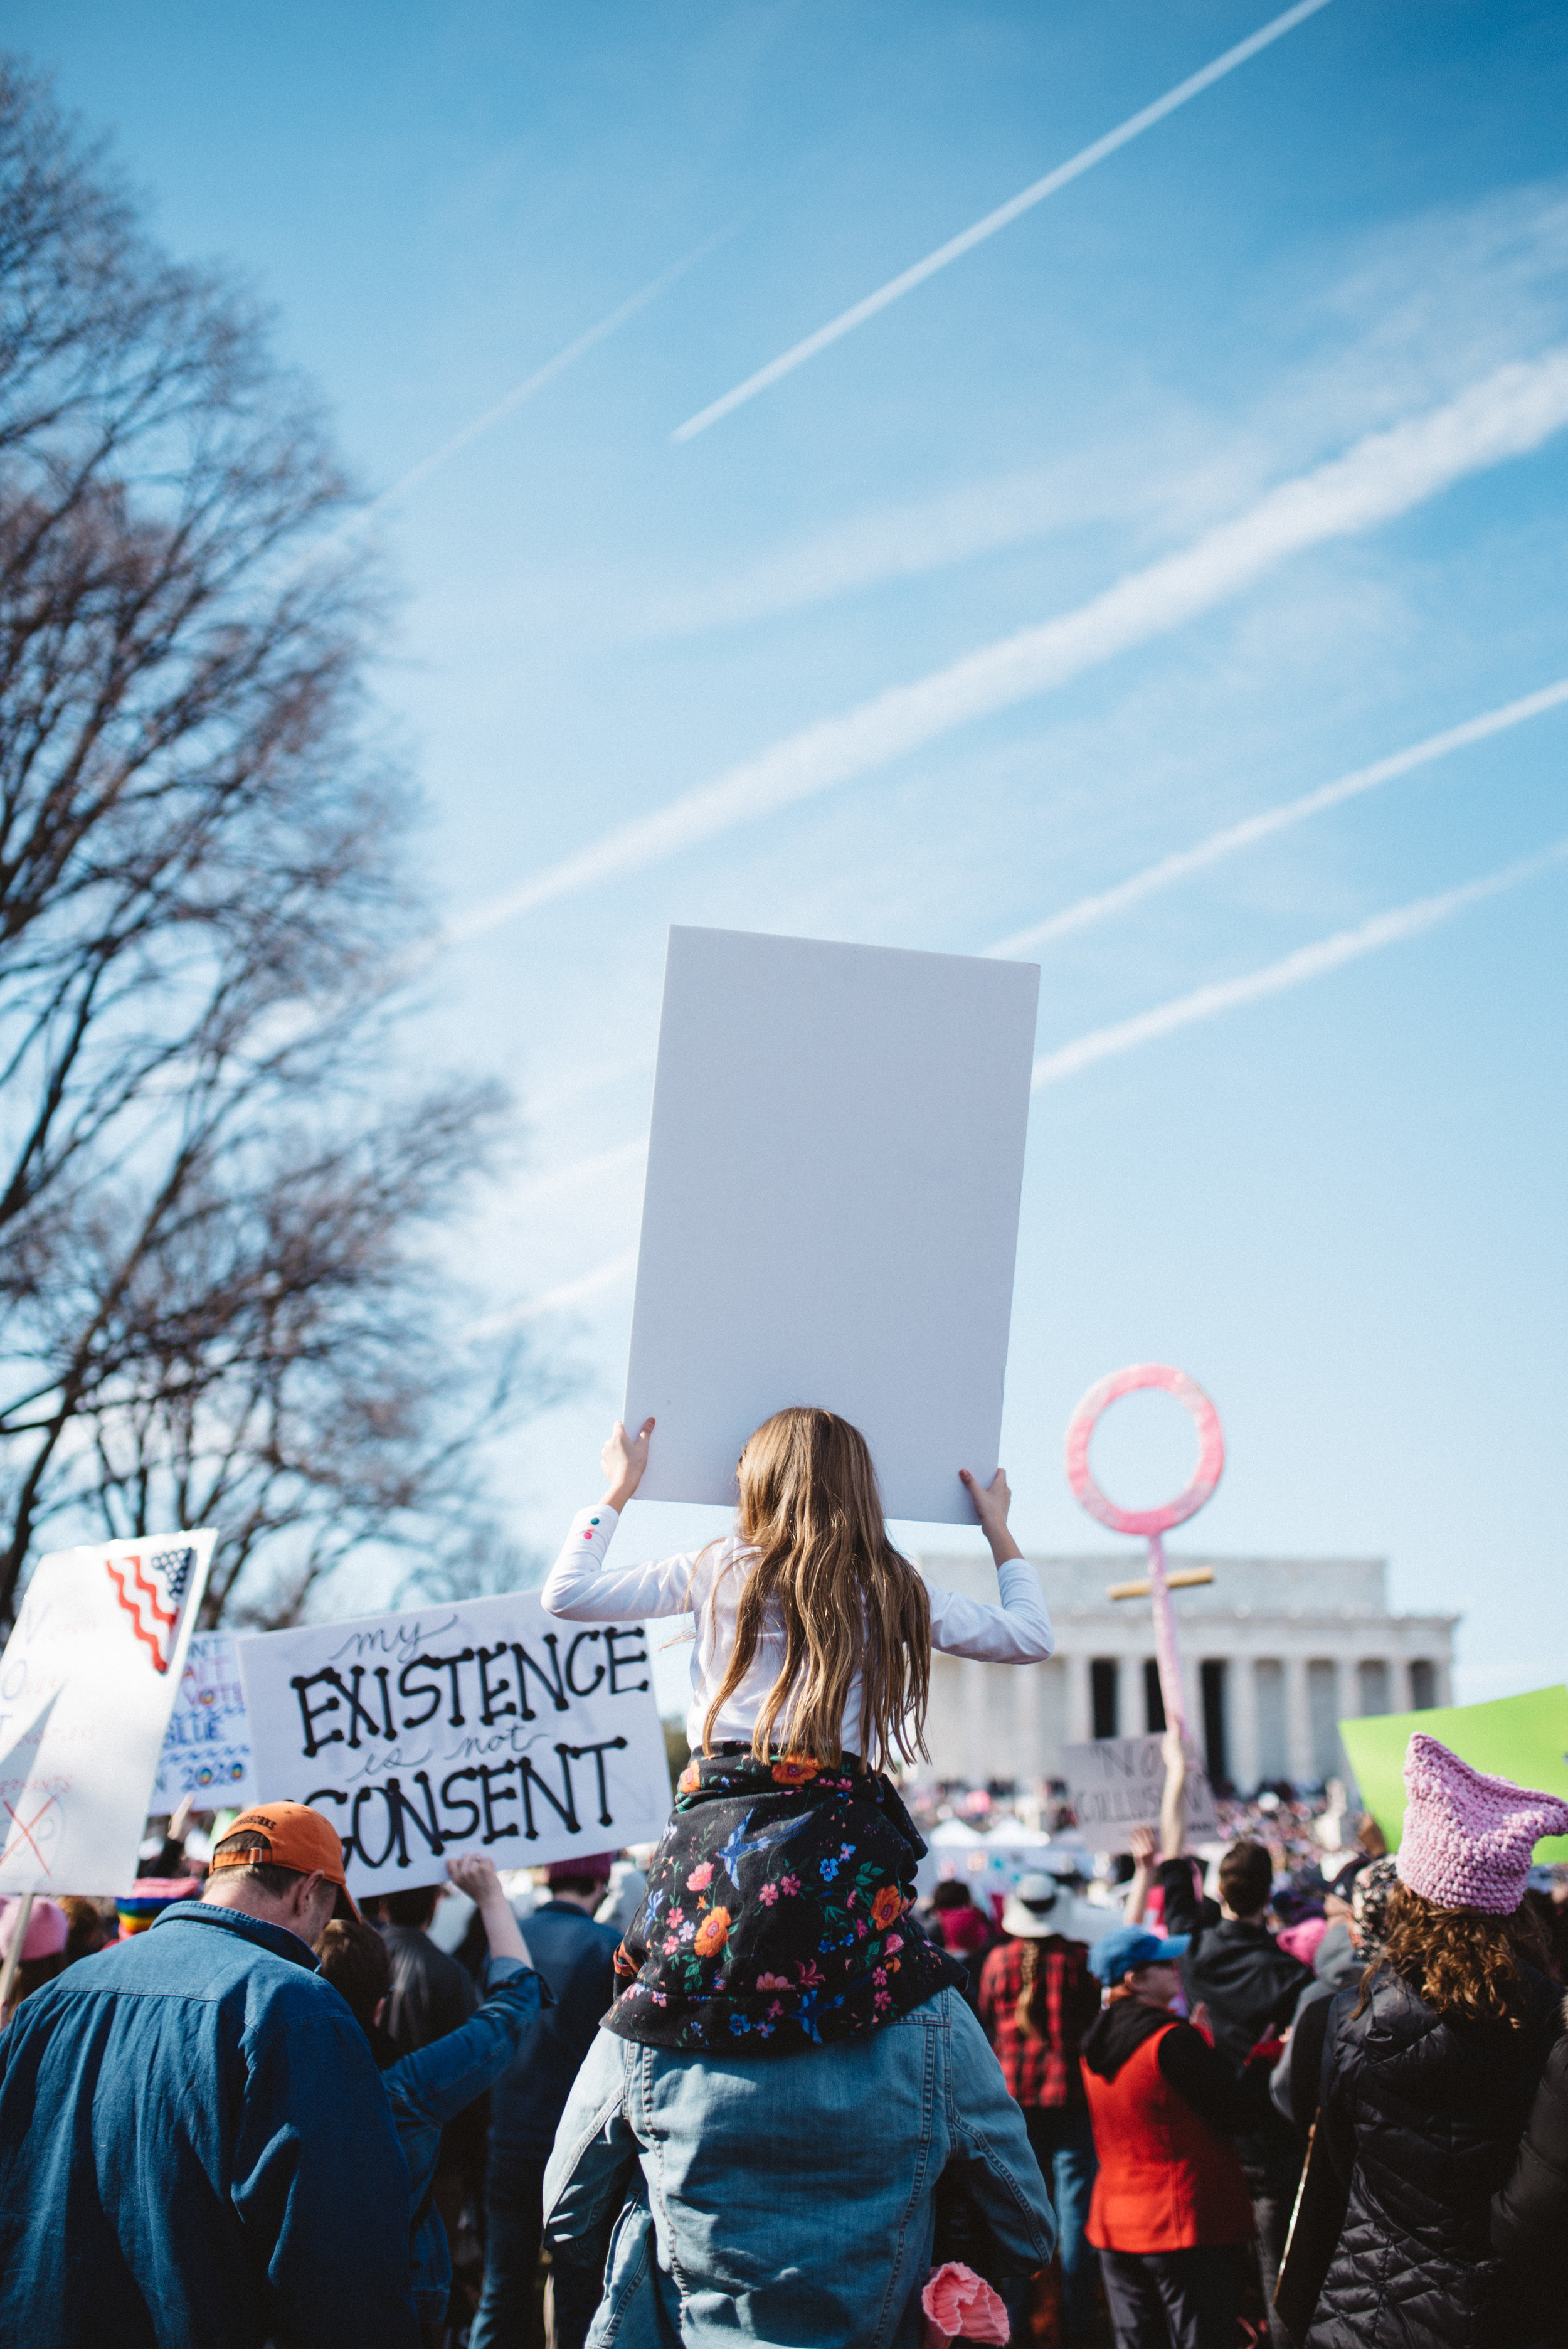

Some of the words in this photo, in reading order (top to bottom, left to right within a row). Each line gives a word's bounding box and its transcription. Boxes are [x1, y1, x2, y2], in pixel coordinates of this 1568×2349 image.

[329, 1614, 458, 1663] my
[291, 1626, 649, 1758] EXISTENCE
[181, 1761, 246, 1792] 2020
[346, 1747, 433, 1782] is
[443, 1724, 549, 1761] not
